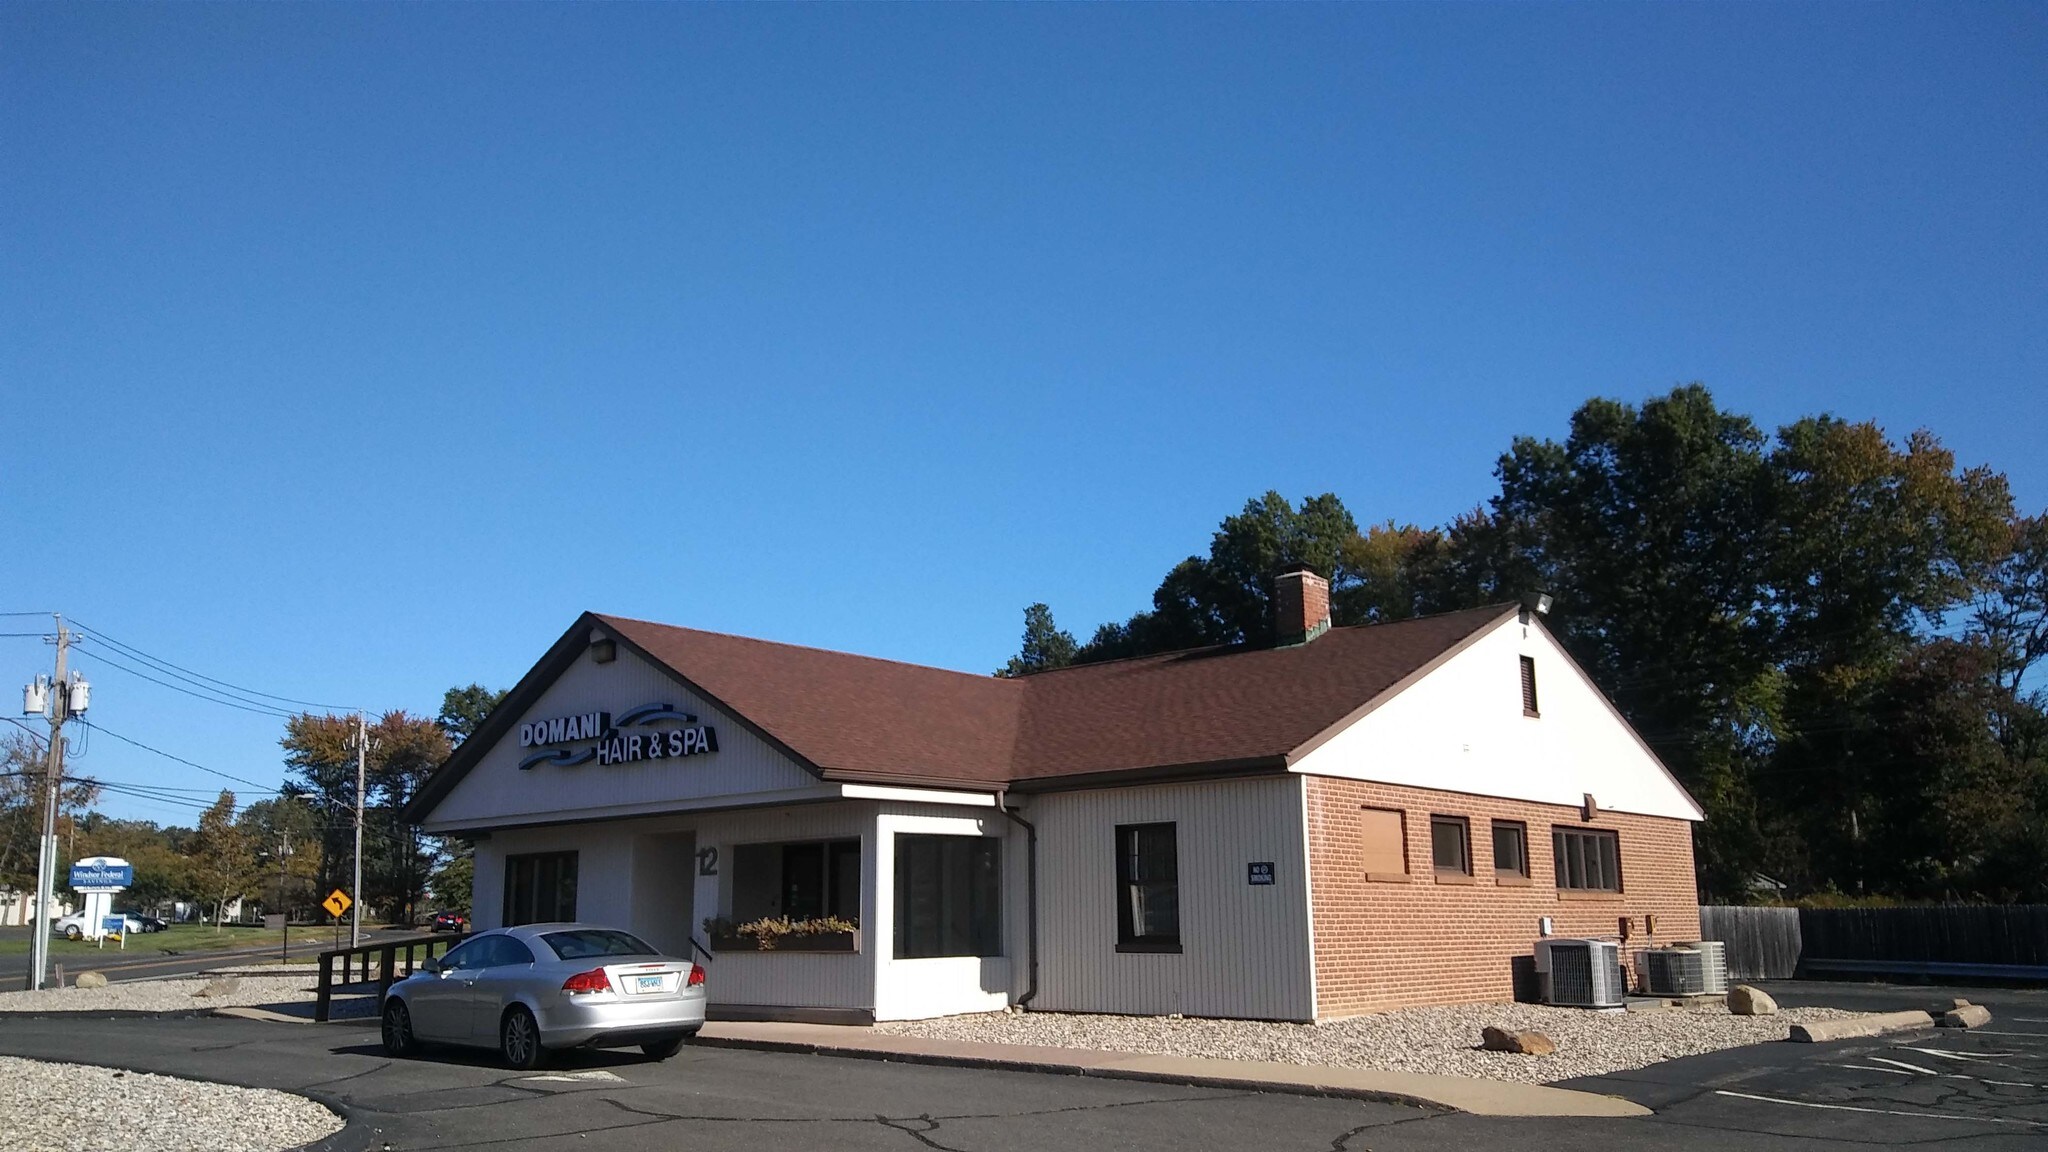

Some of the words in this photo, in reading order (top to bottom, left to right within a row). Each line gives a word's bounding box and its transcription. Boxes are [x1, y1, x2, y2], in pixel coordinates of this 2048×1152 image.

[520, 713, 601, 747] DOMANI
[597, 735, 642, 766] HAIR
[648, 733, 662, 760] &
[668, 726, 709, 758] SPA
[696, 847, 718, 876] 12
